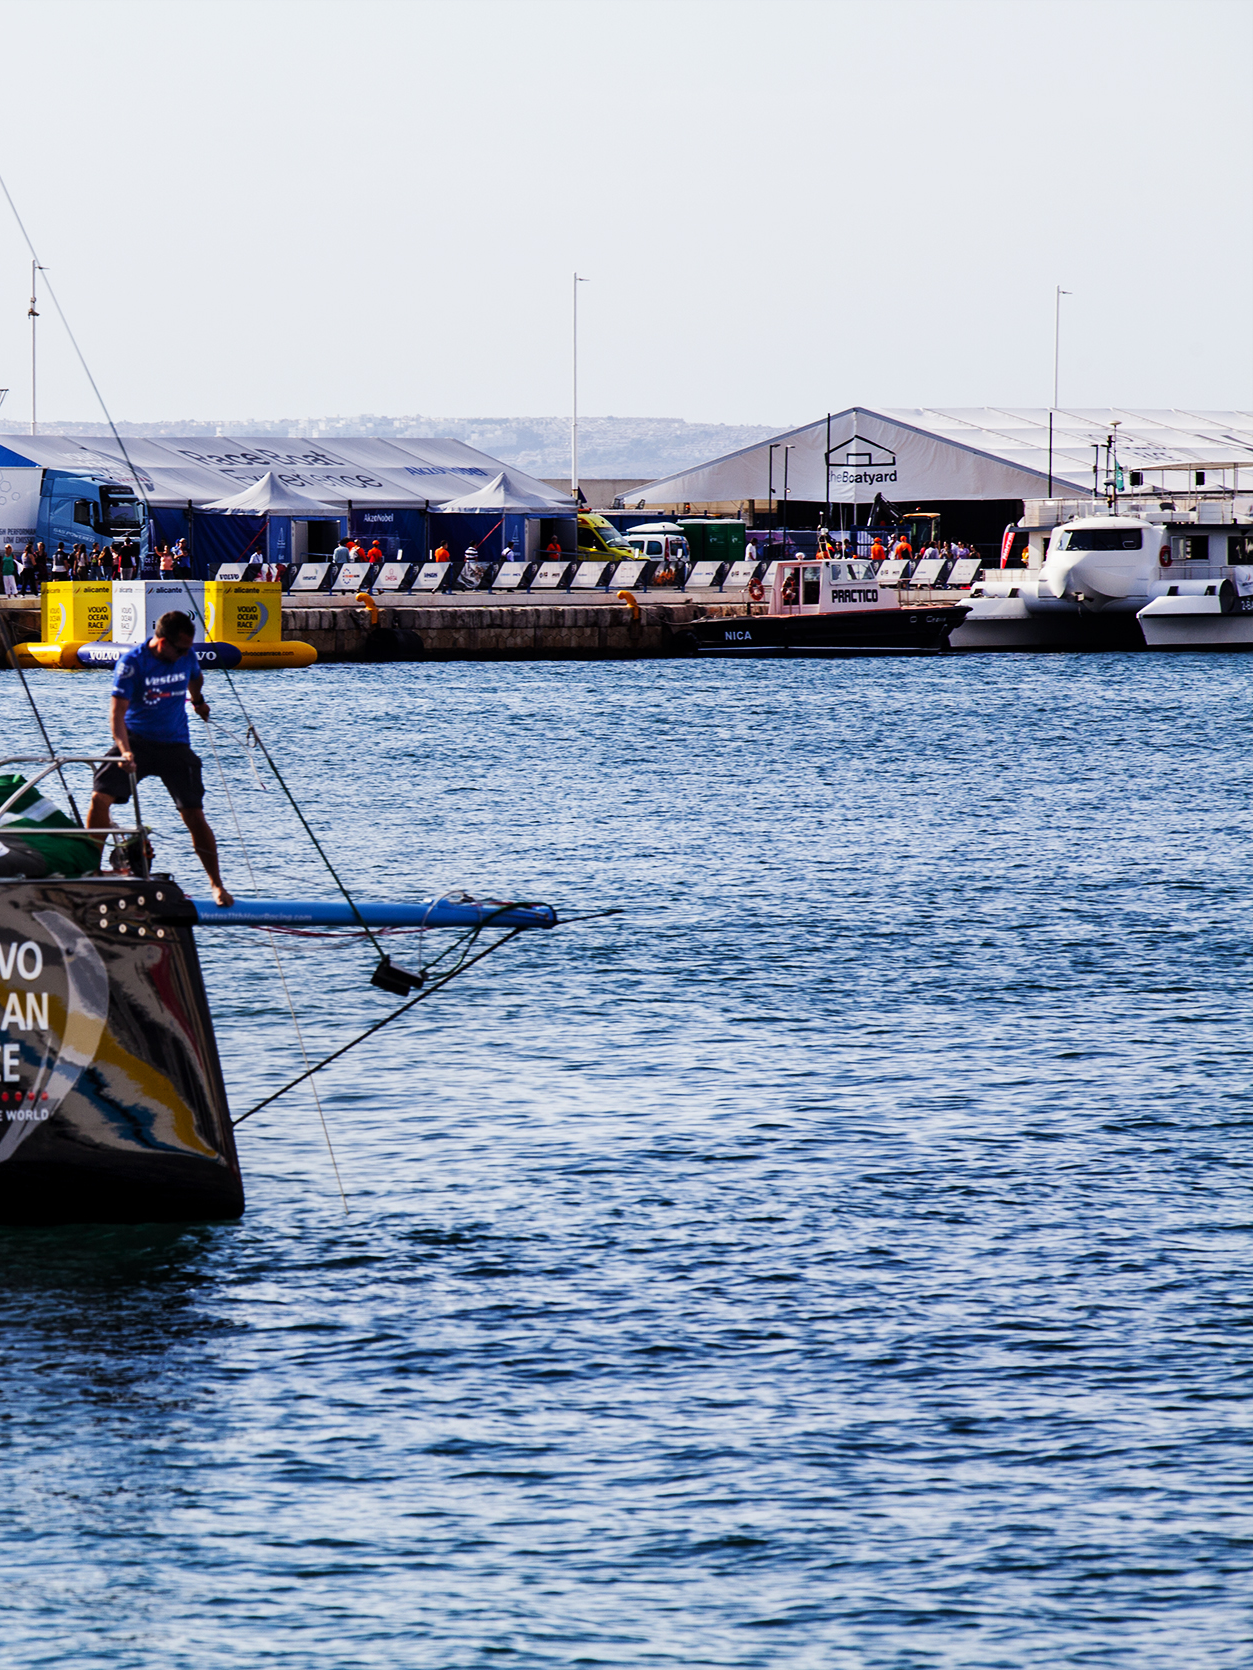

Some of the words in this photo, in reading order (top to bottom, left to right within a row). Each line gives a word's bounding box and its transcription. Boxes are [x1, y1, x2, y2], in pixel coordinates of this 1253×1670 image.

[178, 449, 271, 466] Race
[253, 449, 346, 466] Boat
[363, 513, 394, 522] AkzoNobel
[831, 588, 879, 604] PRACTICO
[725, 631, 752, 641] NICA
[89, 651, 120, 660] VOLVO
[145, 672, 186, 686] Vestas
[6, 1109, 50, 1122] WORLD
